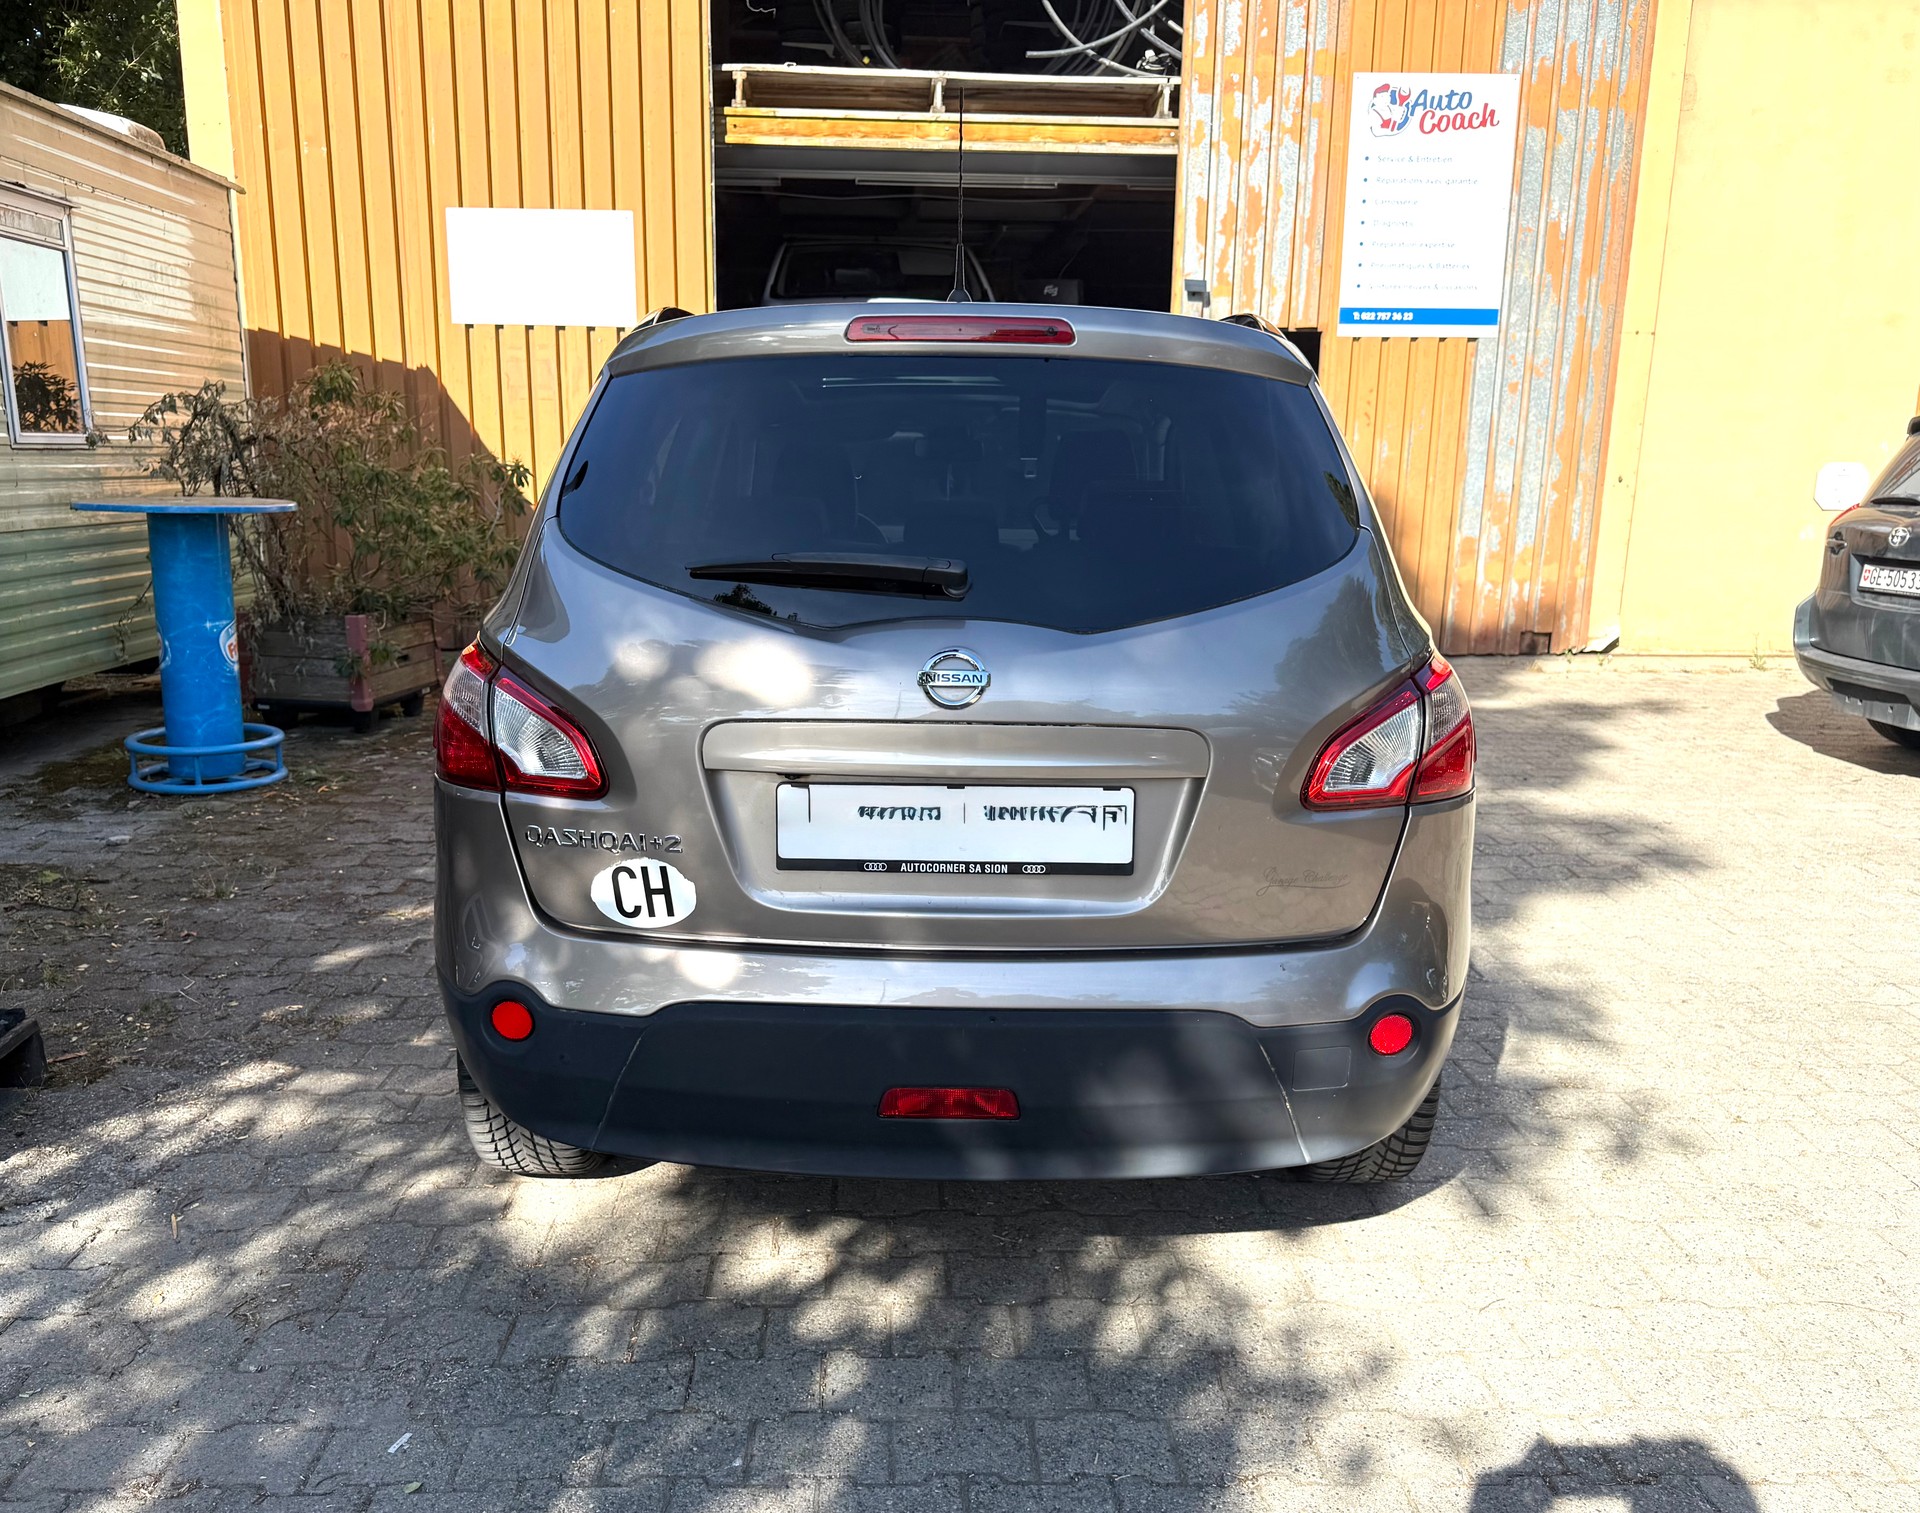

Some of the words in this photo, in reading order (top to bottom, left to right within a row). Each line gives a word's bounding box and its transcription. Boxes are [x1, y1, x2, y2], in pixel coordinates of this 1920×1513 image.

[1410, 89, 1472, 116] Auto
[1419, 103, 1499, 134] Coach
[1377, 154, 1406, 163] Service
[1408, 155, 1414, 163] &
[925, 671, 983, 684] NISSAN
[900, 862, 966, 874] AUTOCORNER
[968, 863, 982, 874] SA
[984, 863, 1008, 874] SION
[611, 865, 675, 919] CH
